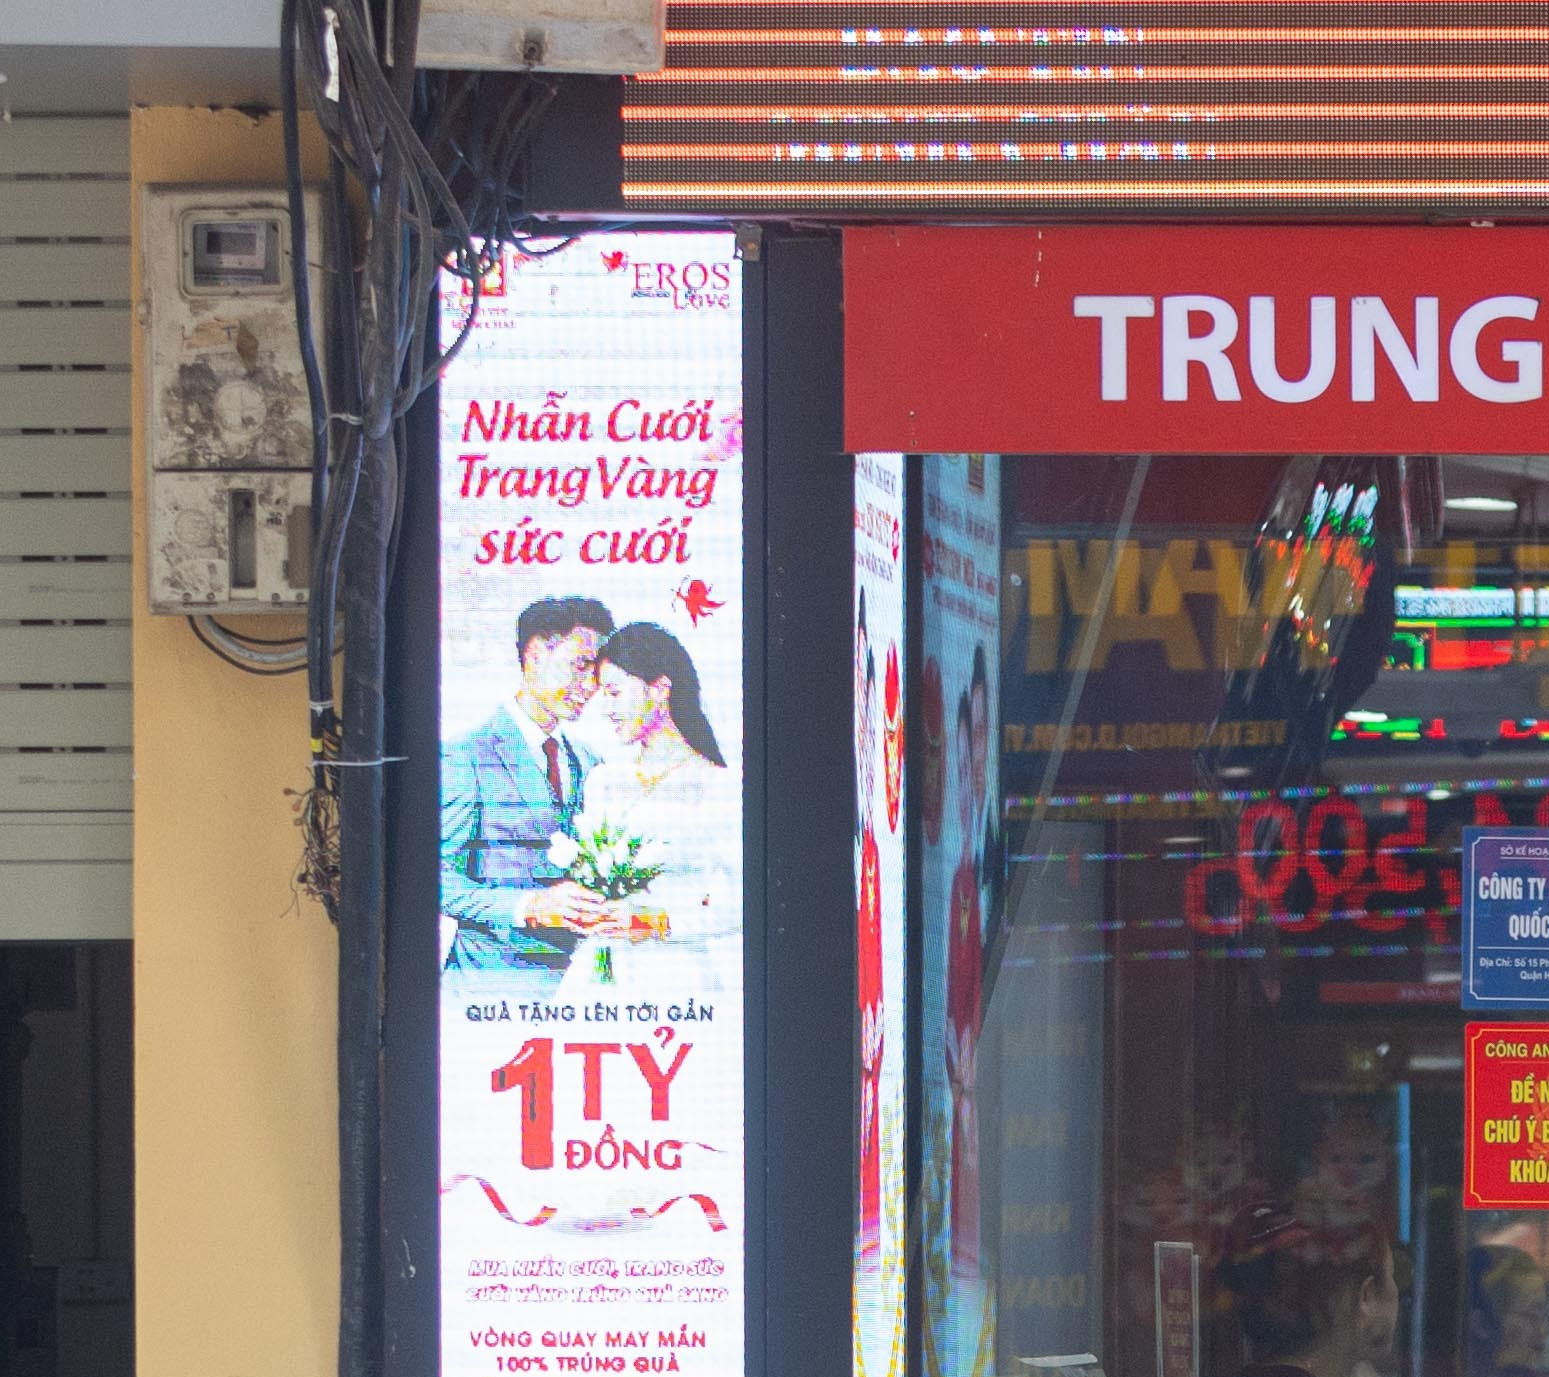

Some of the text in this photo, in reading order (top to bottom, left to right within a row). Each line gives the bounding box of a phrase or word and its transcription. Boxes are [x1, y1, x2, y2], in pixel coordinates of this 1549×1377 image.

[632, 262, 731, 291] EROS
[1074, 294, 1544, 403] TRUNG
[462, 391, 715, 442] Nhẫn Cưới
[457, 453, 719, 509] Trang Vàng
[475, 516, 692, 564] sức cưới
[1479, 873, 1523, 900] CÔNG
[1527, 877, 1545, 900] TY
[1485, 1040, 1528, 1058] CÔNG
[491, 1026, 693, 1170] 1 TỶ
[1511, 1073, 1535, 1104] ĐỀ
[1484, 1115, 1521, 1143] CHÚ
[1526, 1114, 1537, 1143] Ý
[541, 1331, 597, 1348] QUAY
[605, 1331, 651, 1348] MAY
[497, 1357, 548, 1372] 100%
